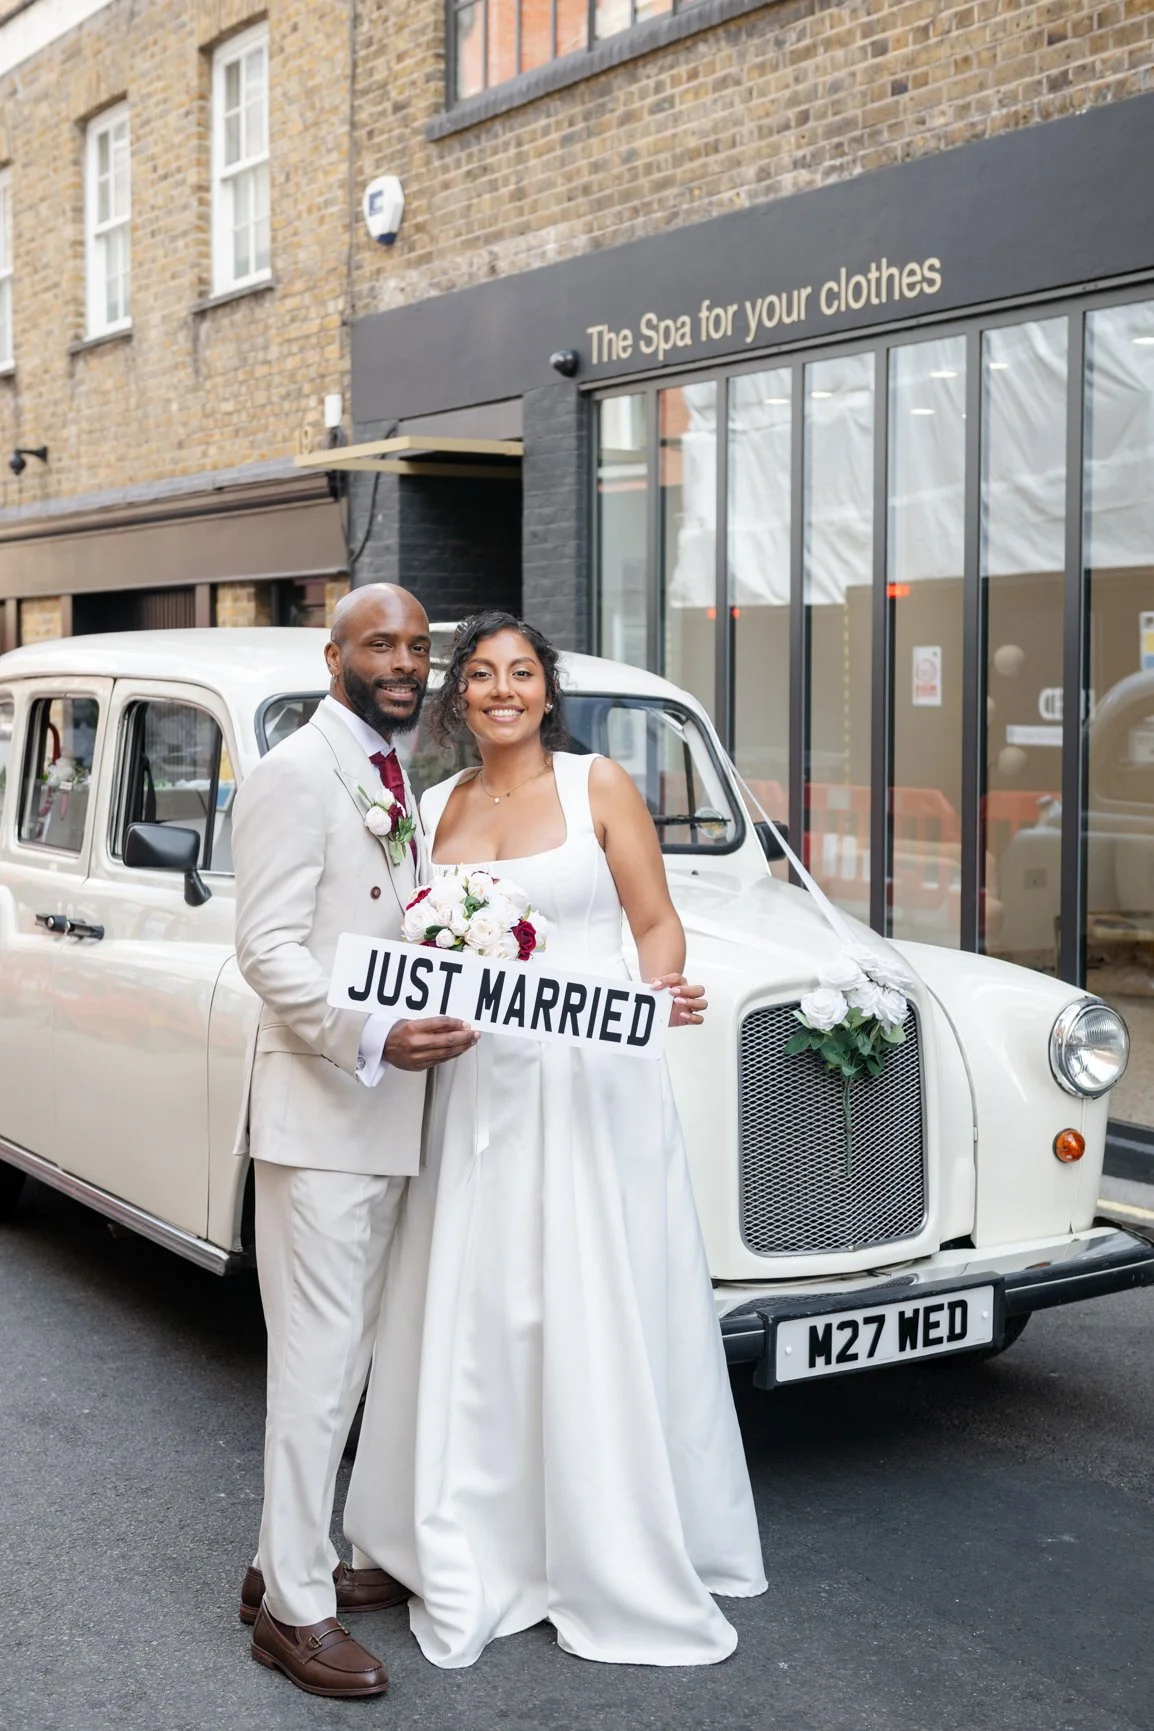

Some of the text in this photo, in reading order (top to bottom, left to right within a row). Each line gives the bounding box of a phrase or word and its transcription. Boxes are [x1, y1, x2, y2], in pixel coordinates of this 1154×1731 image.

[586, 256, 942, 365] The Spa for your clothes
[347, 949, 657, 1048] JUST MARRIED
[808, 1298, 968, 1369] M27 WED
